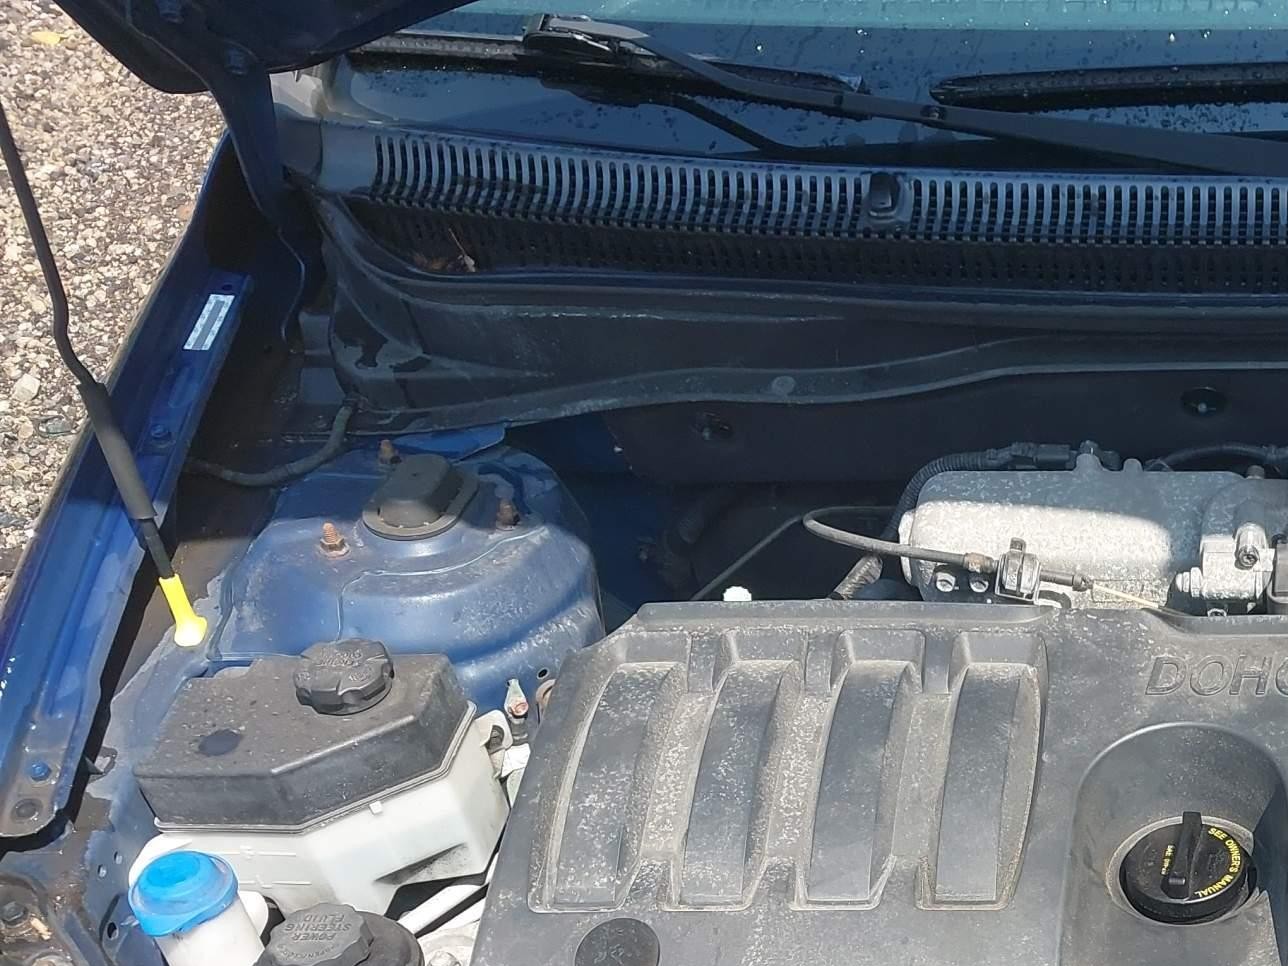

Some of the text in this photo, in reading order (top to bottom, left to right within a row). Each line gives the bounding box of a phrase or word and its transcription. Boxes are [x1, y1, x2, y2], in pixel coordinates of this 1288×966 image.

[1208, 827, 1227, 841] SEE
[1195, 874, 1234, 898] MANUAL
[304, 914, 345, 923] FLUID
[284, 923, 353, 932] STEERING
[292, 933, 337, 941] POWER
